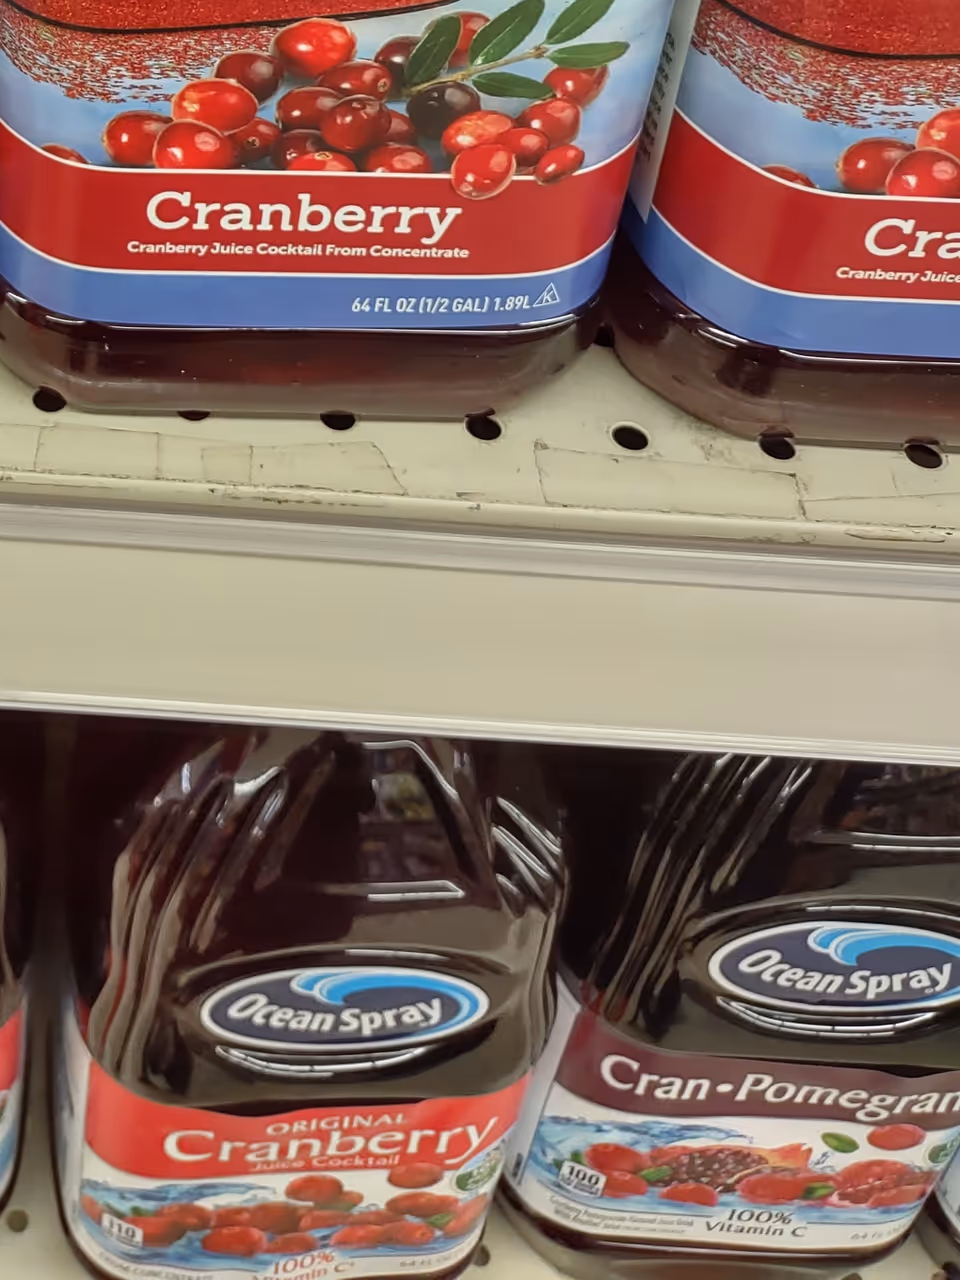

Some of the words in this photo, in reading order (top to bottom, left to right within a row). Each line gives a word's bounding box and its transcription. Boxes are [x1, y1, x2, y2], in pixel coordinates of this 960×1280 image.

[146, 191, 462, 245] Cranberry
[127, 240, 208, 256] Cranberry
[210, 241, 254, 256] Juice
[256, 242, 323, 256] Cocktail
[326, 243, 367, 258] From
[370, 244, 470, 259] Concentrate
[835, 266, 920, 284] Cranberry
[920, 270, 960, 283] Juice
[351, 297, 371, 313] 64
[375, 297, 393, 313] FL
[395, 297, 417, 313] OZ
[419, 296, 449, 315] (1/2
[451, 296, 490, 314] GAL)
[493, 294, 531, 312] 1.89L
[739, 949, 844, 993] Ocean
[844, 962, 952, 1000] Spray
[227, 993, 336, 1032] Ocean
[340, 997, 443, 1035] Spray
[266, 1113, 405, 1136] ORIGINAL
[163, 1116, 498, 1161] Cranberry
[254, 1160, 305, 1170] Juice
[311, 1154, 400, 1167] Cocktail
[727, 1208, 793, 1225] 100%
[705, 1221, 790, 1237] Vitamin
[792, 1226, 808, 1238] C
[274, 1251, 335, 1276] 100%
